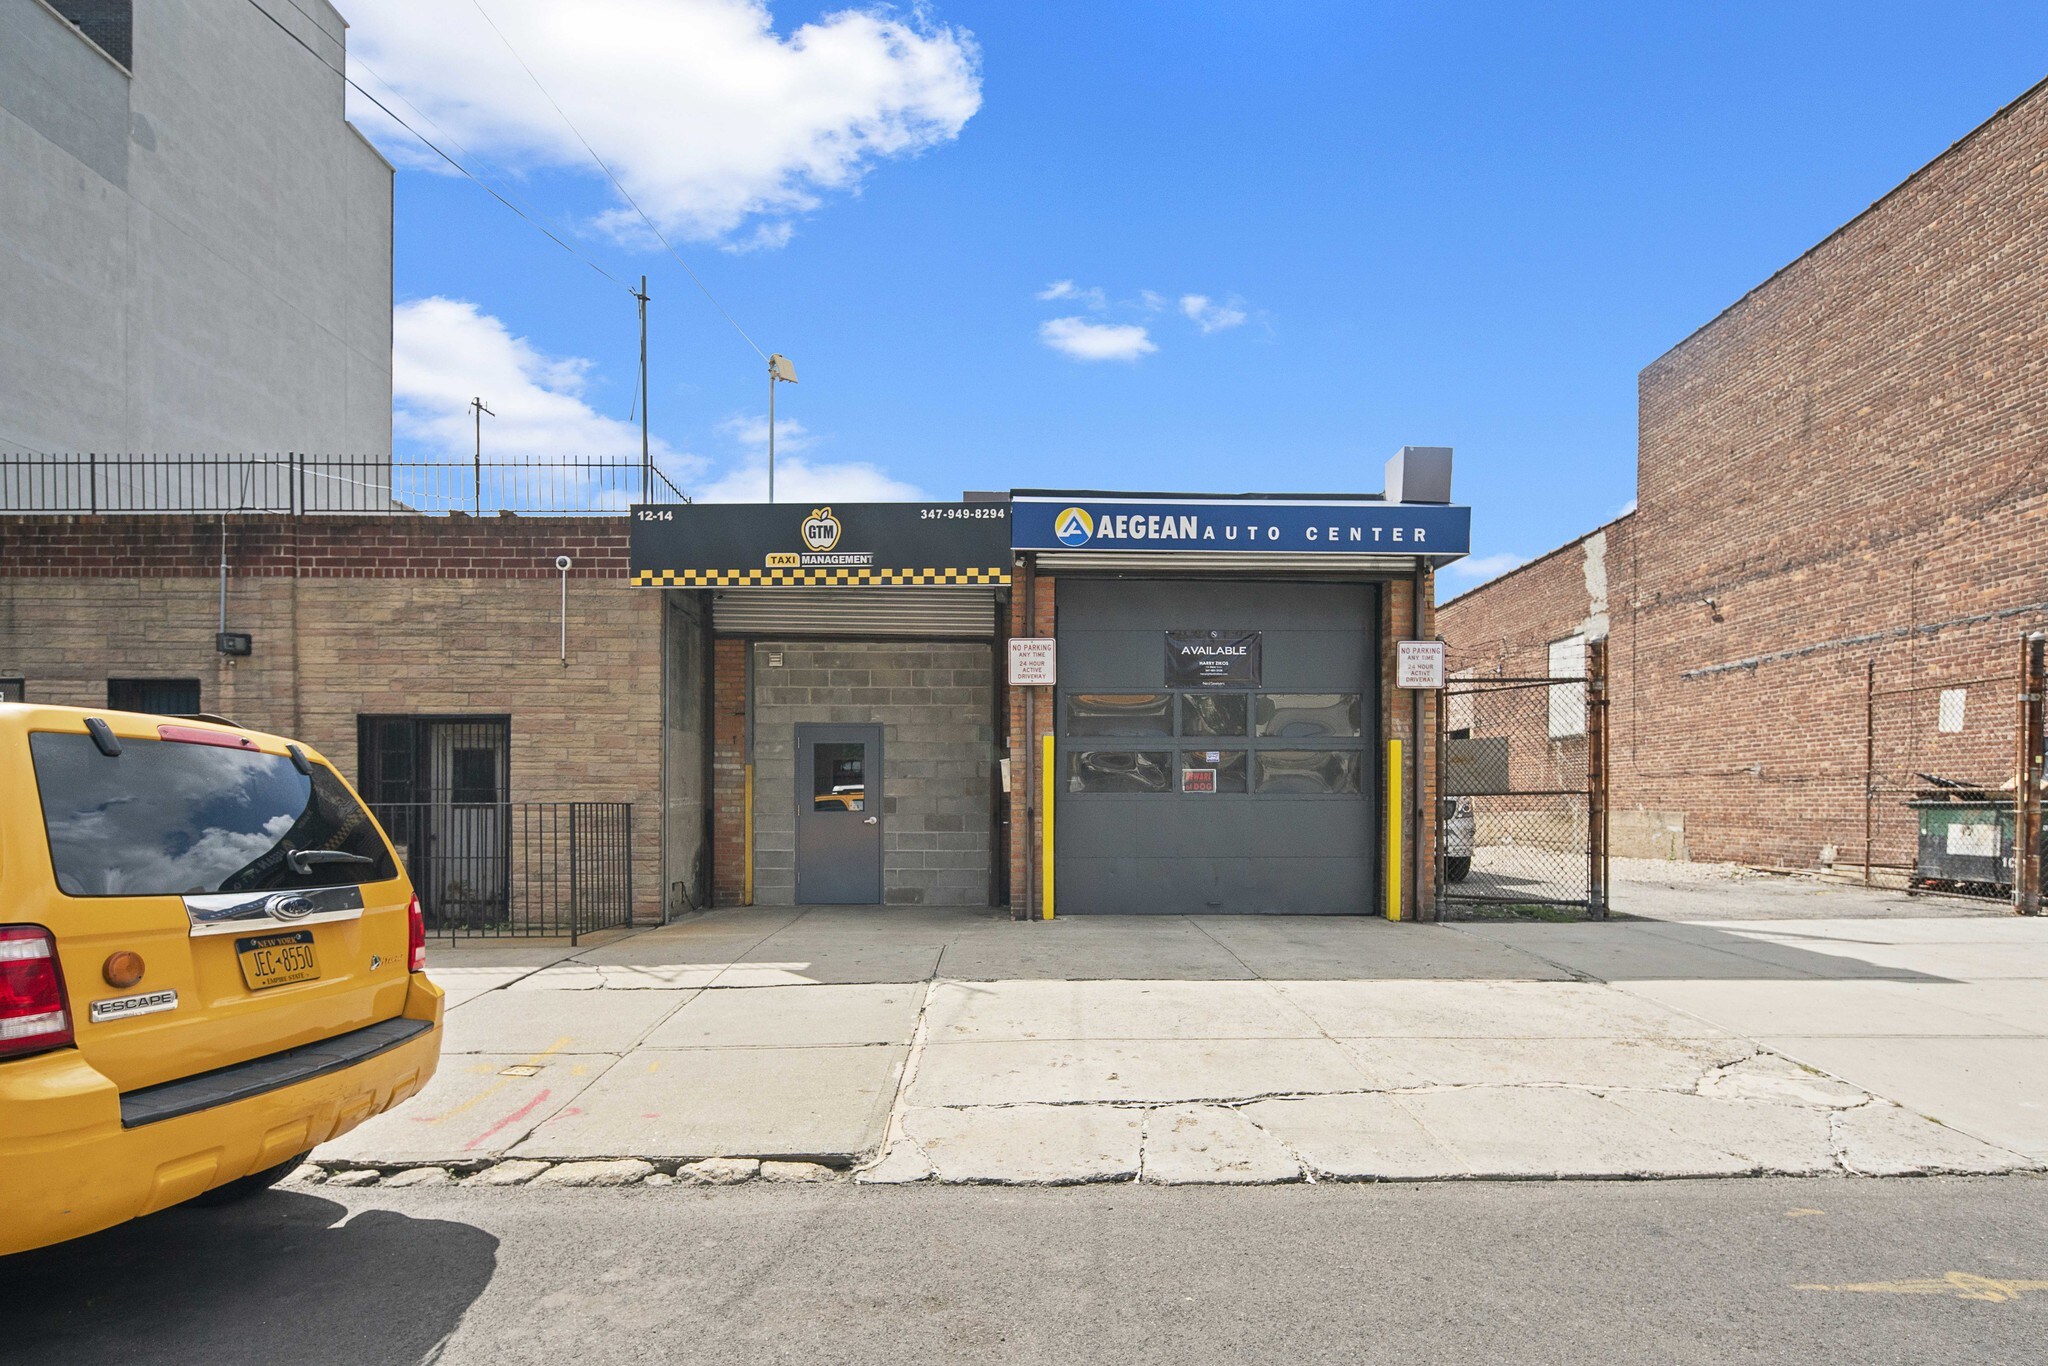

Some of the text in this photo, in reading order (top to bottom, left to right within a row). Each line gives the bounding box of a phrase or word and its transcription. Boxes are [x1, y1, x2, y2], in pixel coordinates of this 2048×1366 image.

[637, 510, 673, 521] 12-14
[920, 508, 1005, 520] 347-949-8294
[808, 525, 834, 539] GTM
[1096, 514, 1426, 542] AEGEAN AUTO CENTER
[771, 555, 873, 564] TAXI MANAGEMENT
[1181, 646, 1247, 655] AVAILABLE
[1194, 782, 1212, 790] DOG
[257, 936, 297, 948] NEW YORK
[266, 972, 304, 985] EMPIRE STATE
[100, 993, 171, 1013] ESCAPE
